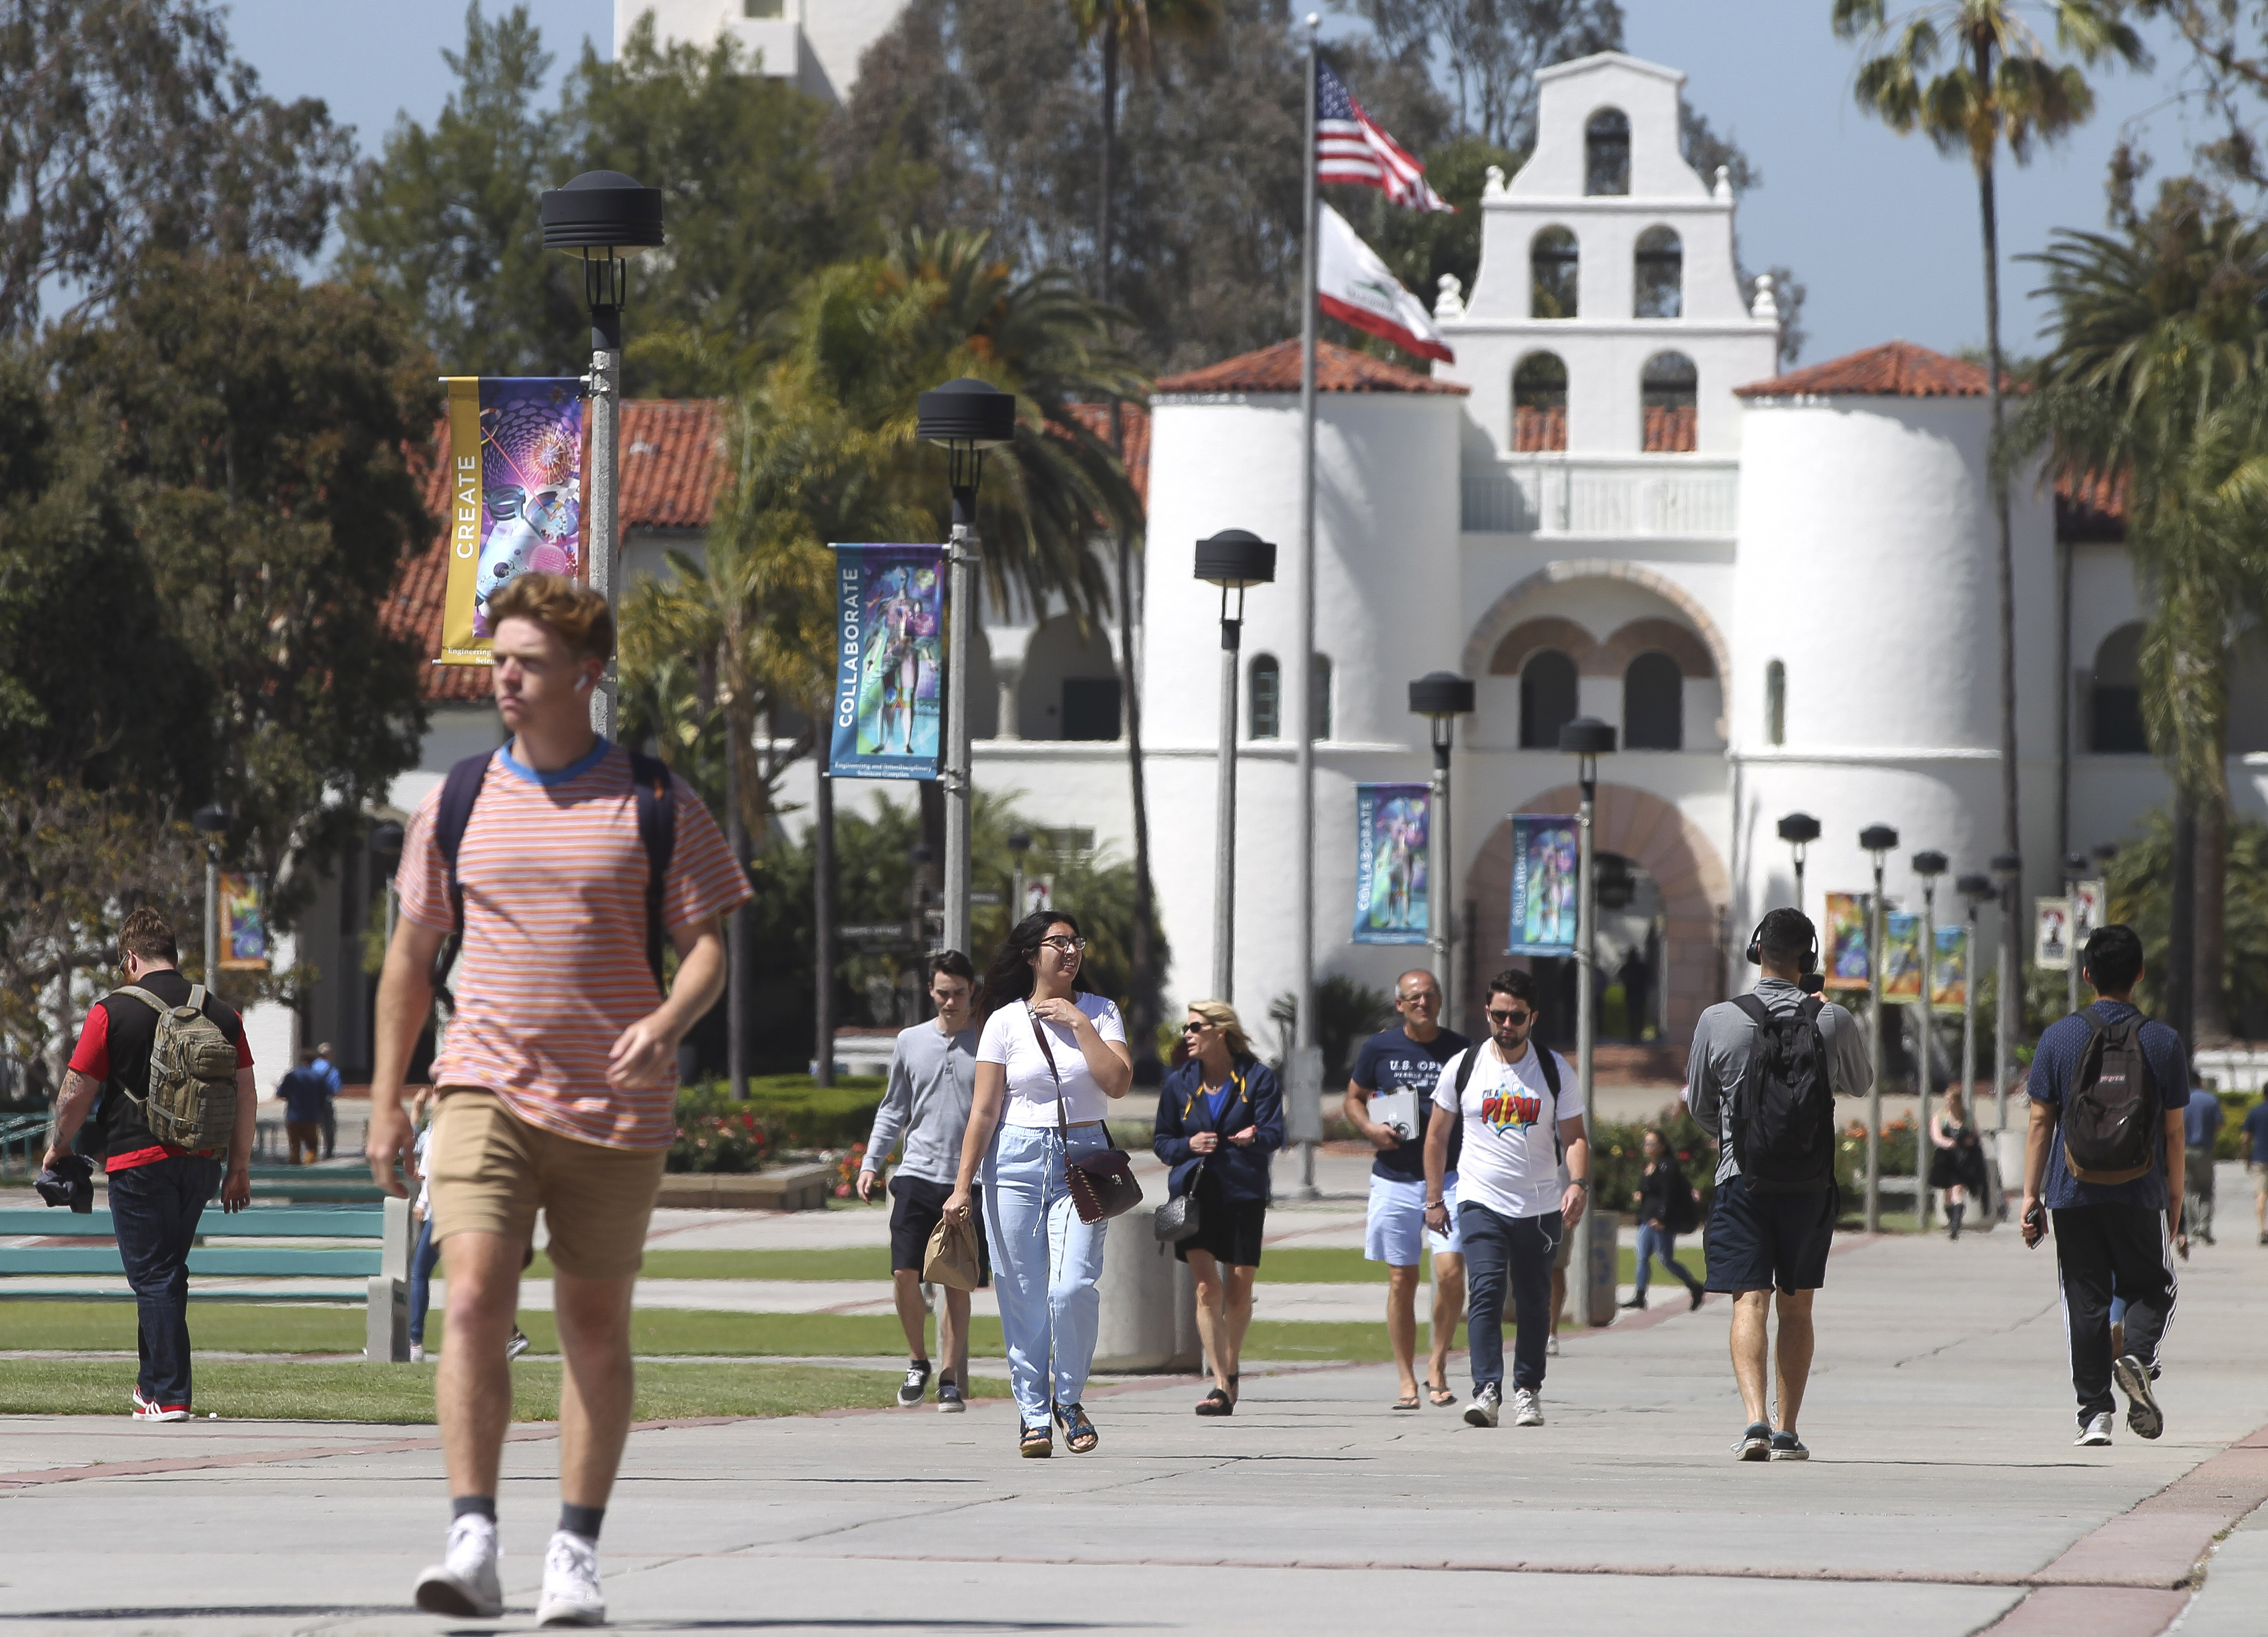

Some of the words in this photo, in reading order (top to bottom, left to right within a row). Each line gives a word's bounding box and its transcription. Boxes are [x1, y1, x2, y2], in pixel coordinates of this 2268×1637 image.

[456, 455, 475, 559] CREATE
[448, 646, 491, 657] Engineering
[838, 568, 859, 728] COLLABORATE
[1482, 1097, 1503, 1124] PI
[1505, 1096, 1541, 1124] PHI
